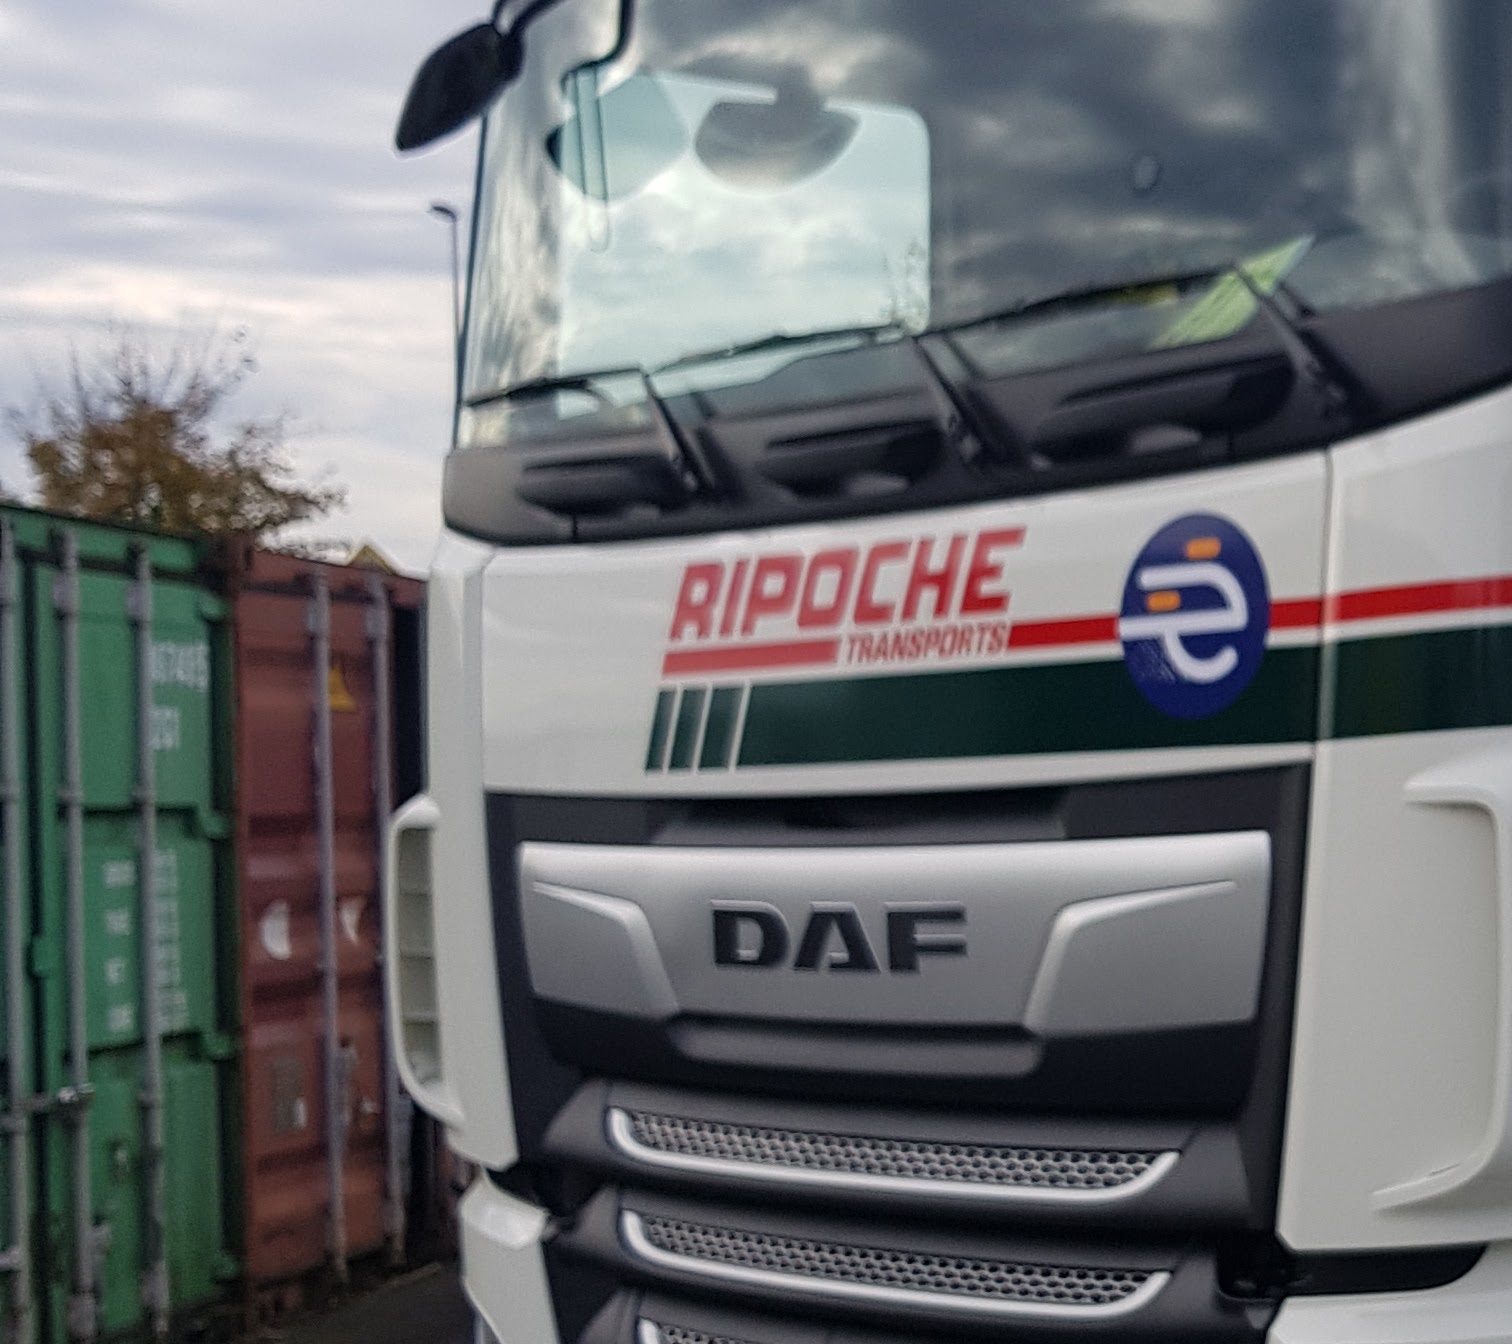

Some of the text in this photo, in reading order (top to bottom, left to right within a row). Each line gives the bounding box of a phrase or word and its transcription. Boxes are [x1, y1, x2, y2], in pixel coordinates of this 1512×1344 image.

[669, 526, 1026, 641] RIPOCHE
[846, 622, 1009, 665] TRANSPORTS
[710, 899, 967, 974] DAF
